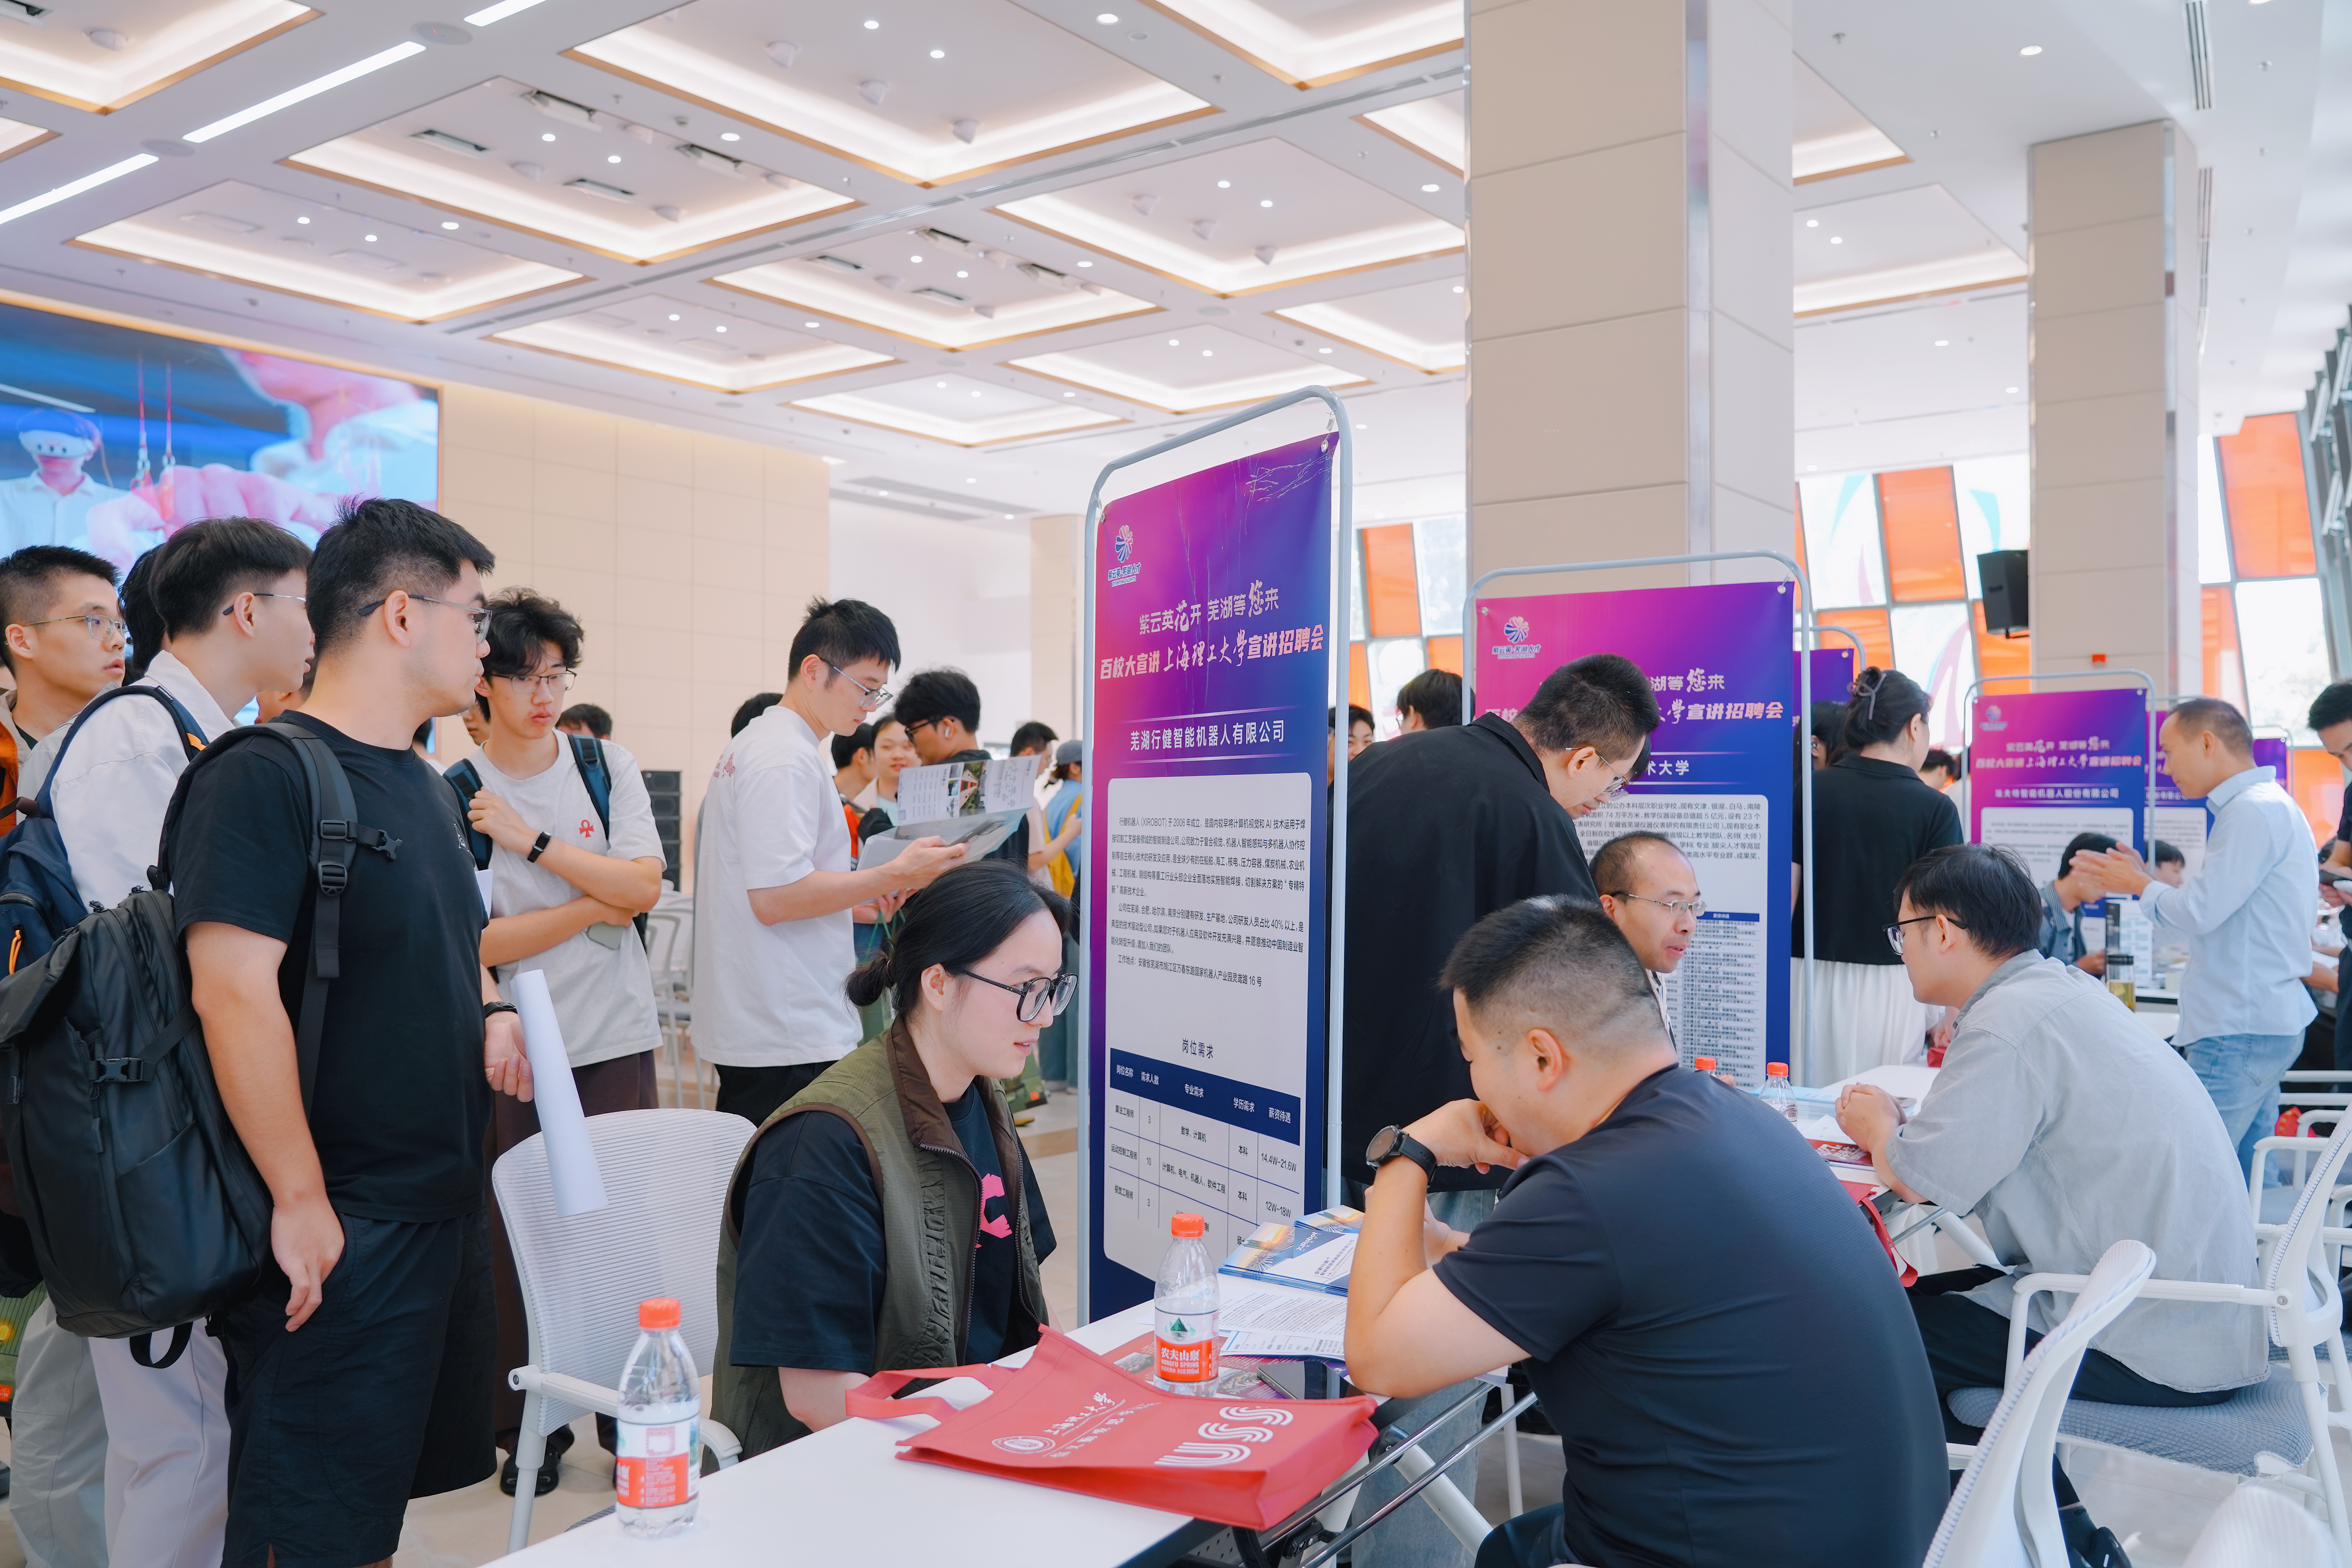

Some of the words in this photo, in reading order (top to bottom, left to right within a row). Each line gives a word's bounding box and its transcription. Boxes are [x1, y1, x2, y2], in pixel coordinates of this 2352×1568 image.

[1140, 600, 1201, 635] 紫云英花开
[1207, 580, 1279, 622] 芜湖等您来
[1650, 668, 1725, 693] 湖等您来
[1130, 720, 1284, 751] 芜湖行健智能机器人有限公司
[1173, 818, 1185, 827] 2006
[1265, 819, 1272, 829] AI
[1273, 819, 1306, 829] 技术运用于焊
[1271, 919, 1283, 930] 40%
[1249, 976, 1256, 985] 16
[1257, 976, 1262, 987] 号
[1182, 1038, 1213, 1058] 岗位需求
[1116, 1064, 1134, 1078] 岗位名称
[1141, 1071, 1160, 1085] 需求人数
[1184, 1083, 1204, 1098] 专业需求
[1233, 1097, 1255, 1112] 学历需求
[1269, 1107, 1291, 1124] 薪资待遇
[1115, 1105, 1134, 1118] 算法工程师
[1148, 1116, 1151, 1124] 3
[1181, 1126, 1206, 1142] 数学、计算机
[1238, 1145, 1248, 1156] 本科
[1147, 1157, 1152, 1165] 10
[1238, 1190, 1247, 1202] 本科
[1161, 1347, 1199, 1361] 农夫山泉
[1161, 1359, 1178, 1367] NONGFU
[1153, 1406, 1294, 1467] USS
